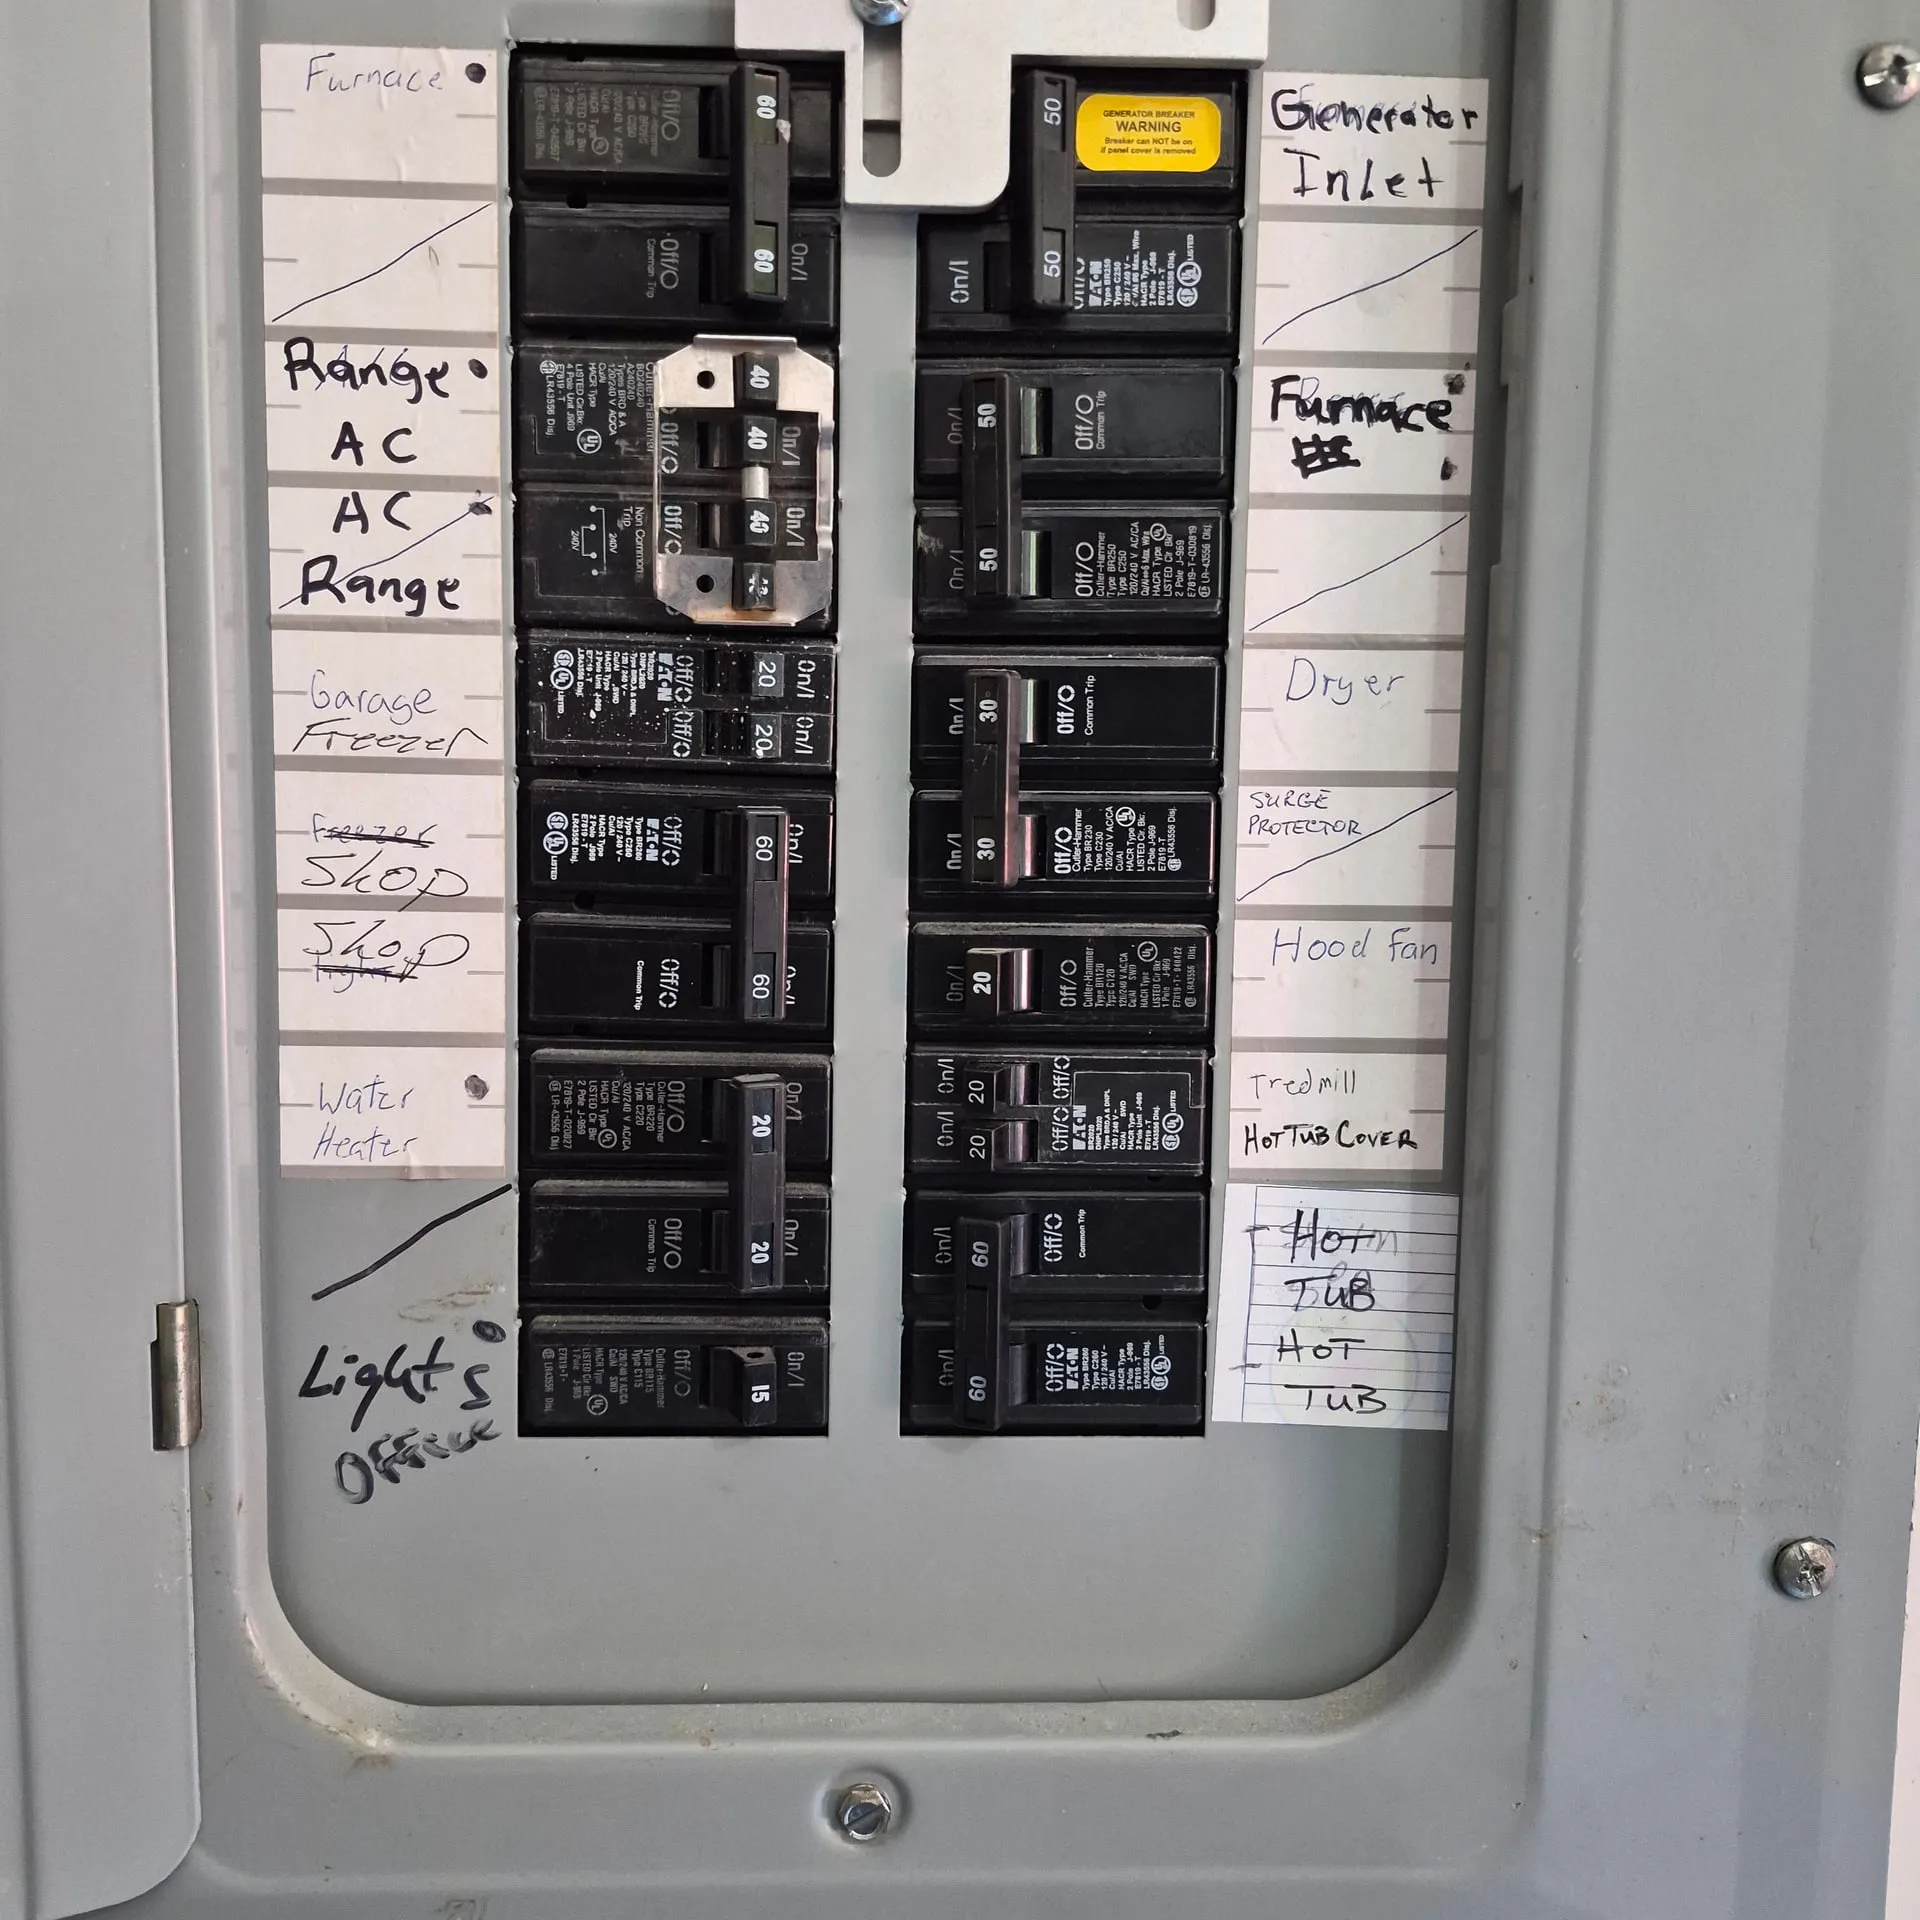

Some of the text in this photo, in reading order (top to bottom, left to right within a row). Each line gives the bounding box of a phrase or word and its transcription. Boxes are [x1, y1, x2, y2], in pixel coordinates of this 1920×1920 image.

[306, 53, 443, 91] Furnace
[757, 95, 776, 120] 60
[1044, 97, 1062, 126] 50
[1103, 110, 1195, 119] GENERATOR BREAKER
[1271, 88, 1478, 134] Generator
[1115, 120, 1182, 133] WARNING
[1105, 137, 1134, 145] Breaker
[1108, 147, 1129, 156] panel
[1162, 147, 1196, 155] removed
[754, 249, 774, 274] 60
[1043, 250, 1062, 278] 50
[284, 337, 450, 404] Range
[750, 365, 770, 389] 40
[978, 404, 997, 428] 50
[1270, 374, 1453, 433] Furnace
[1096, 391, 1106, 450] Common Trip
[748, 427, 767, 450] 40
[622, 506, 633, 527] Trip
[750, 510, 769, 533] 40
[571, 530, 580, 552] 240V
[609, 532, 618, 554] 240V
[635, 506, 645, 573] Non Common
[979, 548, 998, 572] 50
[300, 555, 459, 617] Range
[758, 661, 776, 687] 20
[1286, 656, 1405, 706] Dryer
[311, 669, 438, 725] Garage
[1085, 675, 1096, 736] Common Trip
[979, 699, 998, 722] 30
[755, 724, 773, 750] 20
[1249, 790, 1332, 810] SURGE
[1248, 814, 1362, 836] PROTECTOR
[755, 835, 773, 861] 60
[977, 837, 995, 861] 30
[1095, 831, 1104, 851] C230
[1126, 848, 1134, 872] HACR
[1137, 843, 1145, 872] LISTED
[1271, 926, 1371, 966] Hood
[633, 960, 644, 1011] Common Trip
[753, 973, 770, 999] 60
[973, 971, 991, 995] 20
[319, 1074, 414, 1115] Water
[968, 1080, 984, 1105] 20
[1250, 1068, 1356, 1100] Tredmill
[752, 1114, 771, 1138] 20
[312, 1121, 418, 1162] Heater
[969, 1135, 985, 1160] 20
[646, 1218, 656, 1273] Common Trip
[1077, 1209, 1086, 1258] Common Trip
[751, 1241, 770, 1264] 20
[971, 1241, 989, 1268] 60
[1276, 1328, 1366, 1363] HOT
[298, 1336, 491, 1432] Lights
[751, 1384, 770, 1403] 15
[968, 1376, 987, 1402] 60
[1283, 1384, 1388, 1414] TUB
